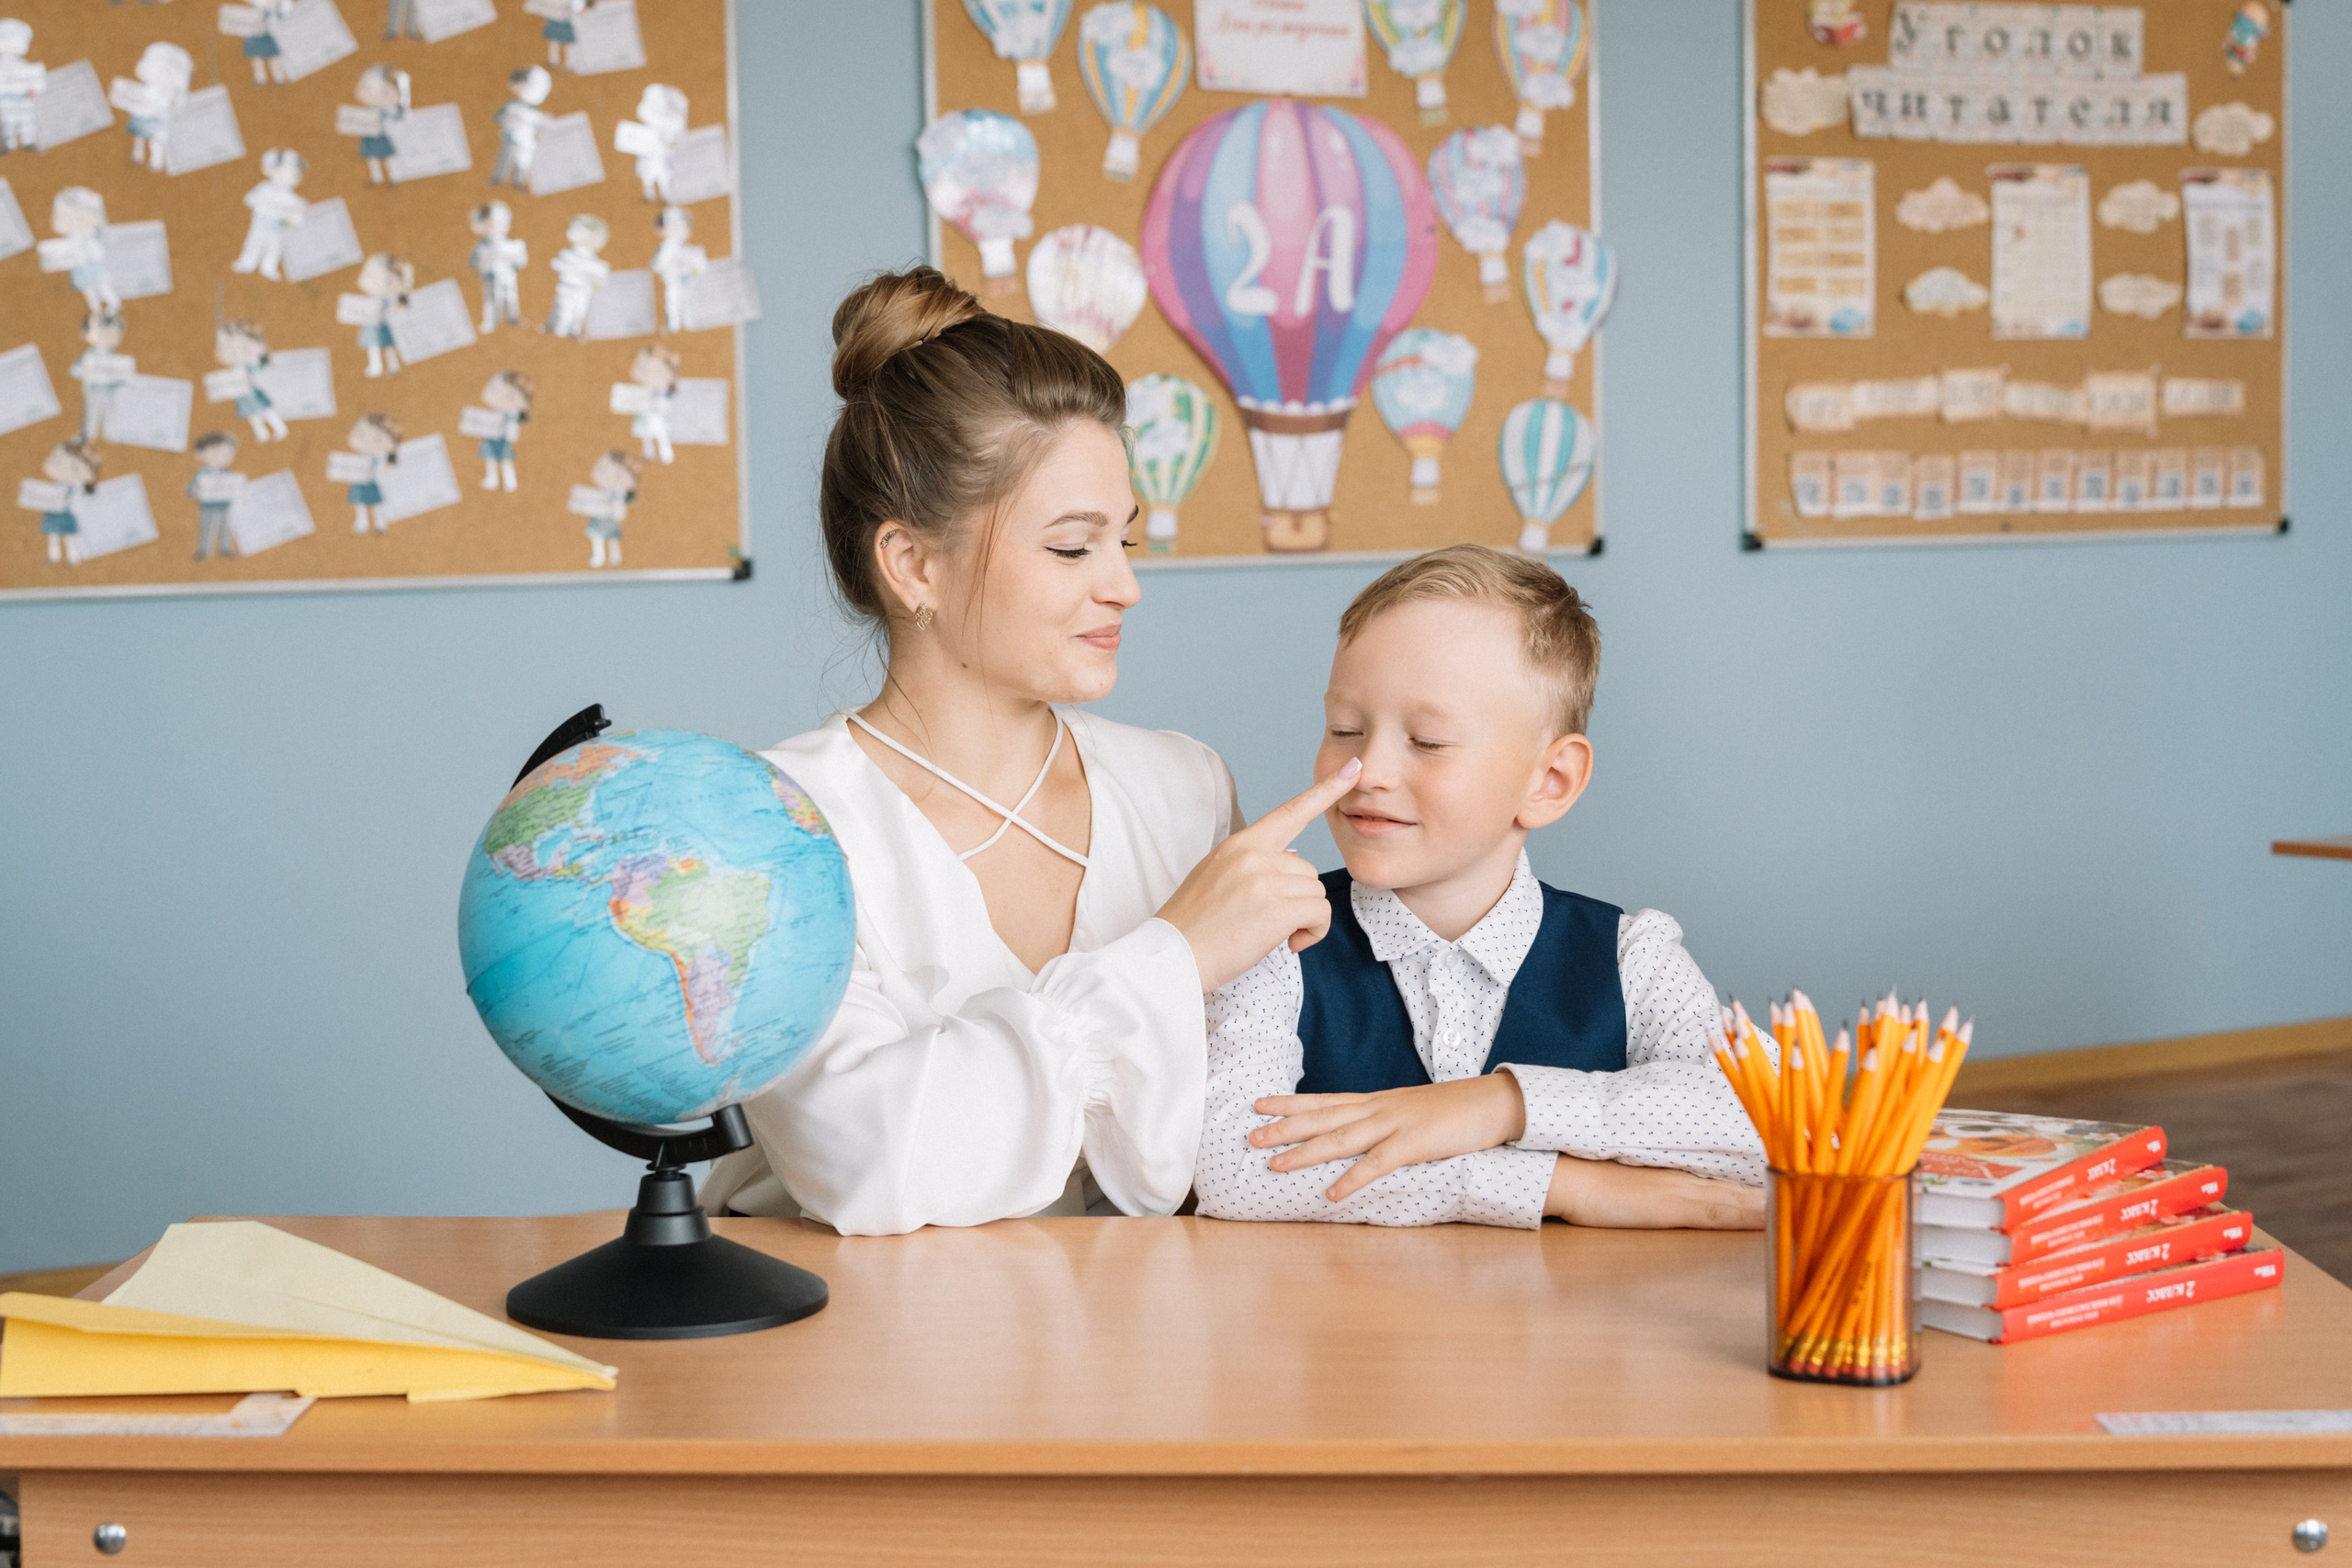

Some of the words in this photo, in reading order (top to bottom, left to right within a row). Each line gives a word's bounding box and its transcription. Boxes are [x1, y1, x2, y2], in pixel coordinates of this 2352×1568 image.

[1894, 9, 2133, 58] Уголок
[1860, 89, 2173, 128] читателя
[2107, 1157, 2117, 1175] 2
[2149, 1199, 2159, 1217] 2
[2161, 1243, 2171, 1261] 2
[2185, 1280, 2196, 1299] 2
